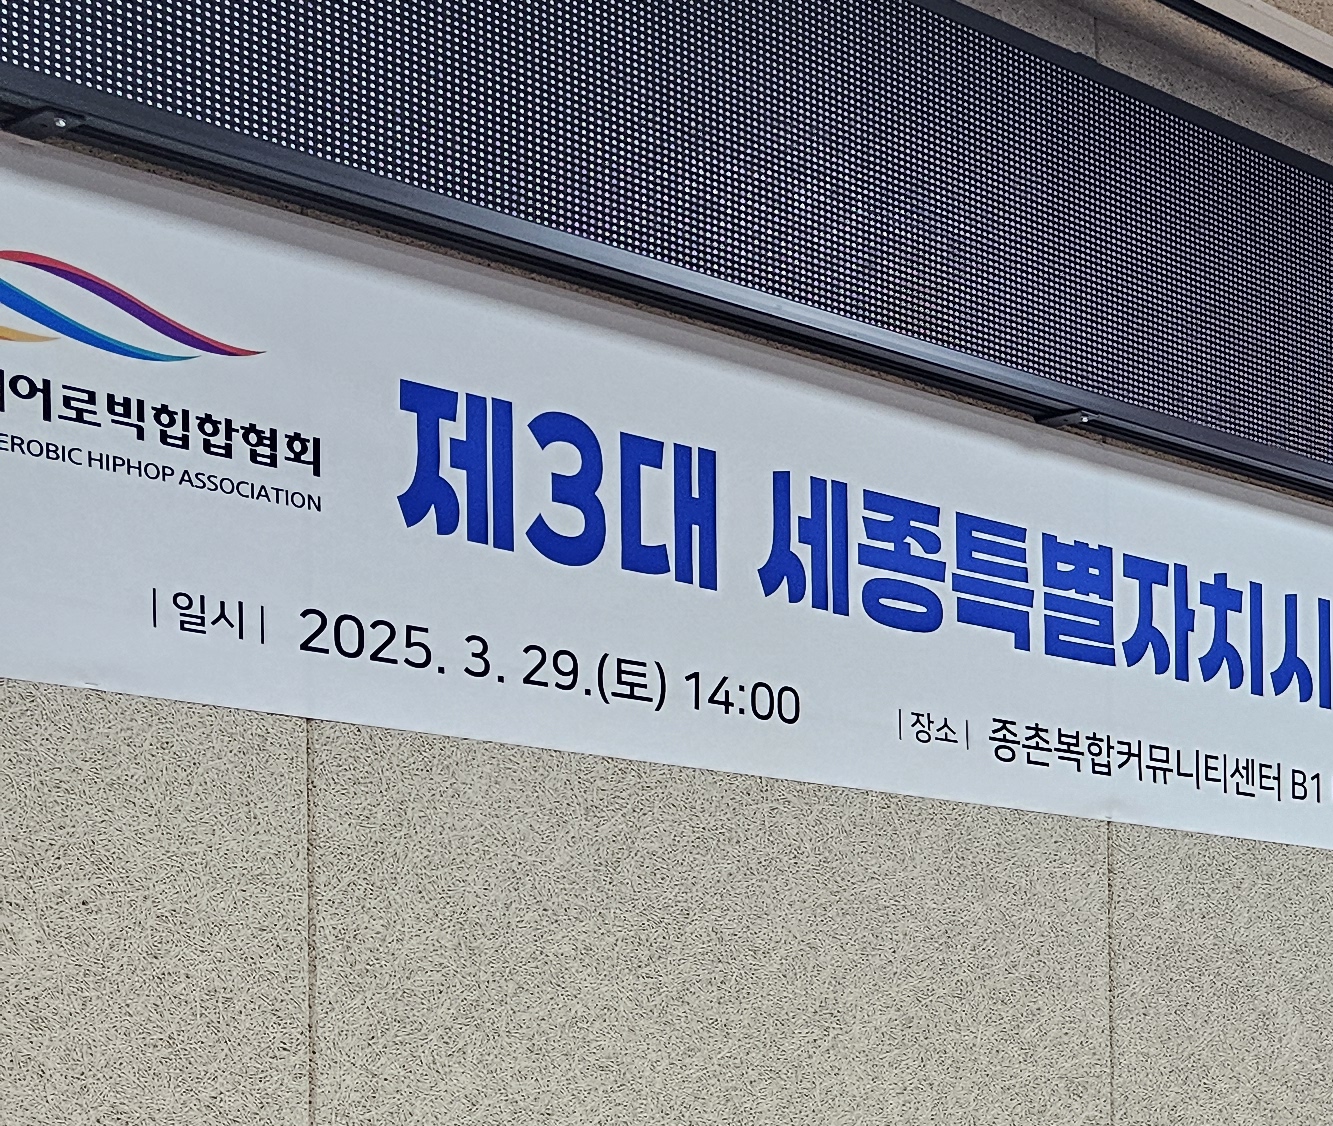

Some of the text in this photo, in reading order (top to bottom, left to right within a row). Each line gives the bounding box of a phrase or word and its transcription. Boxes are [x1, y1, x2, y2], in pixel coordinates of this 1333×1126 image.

[0, 369, 320, 477] 어로빅힙합협회
[88, 451, 174, 481] HIPHOP
[179, 470, 321, 512] ASSOCIATION
[398, 380, 717, 590] 제3대
[758, 471, 1331, 709] 세종특별자치시
[300, 609, 799, 724] 2025. 3. 29.(토) 14:00
[989, 718, 1281, 801] 종촌복합커뮤니티센터
[1292, 769, 1320, 803] B1
